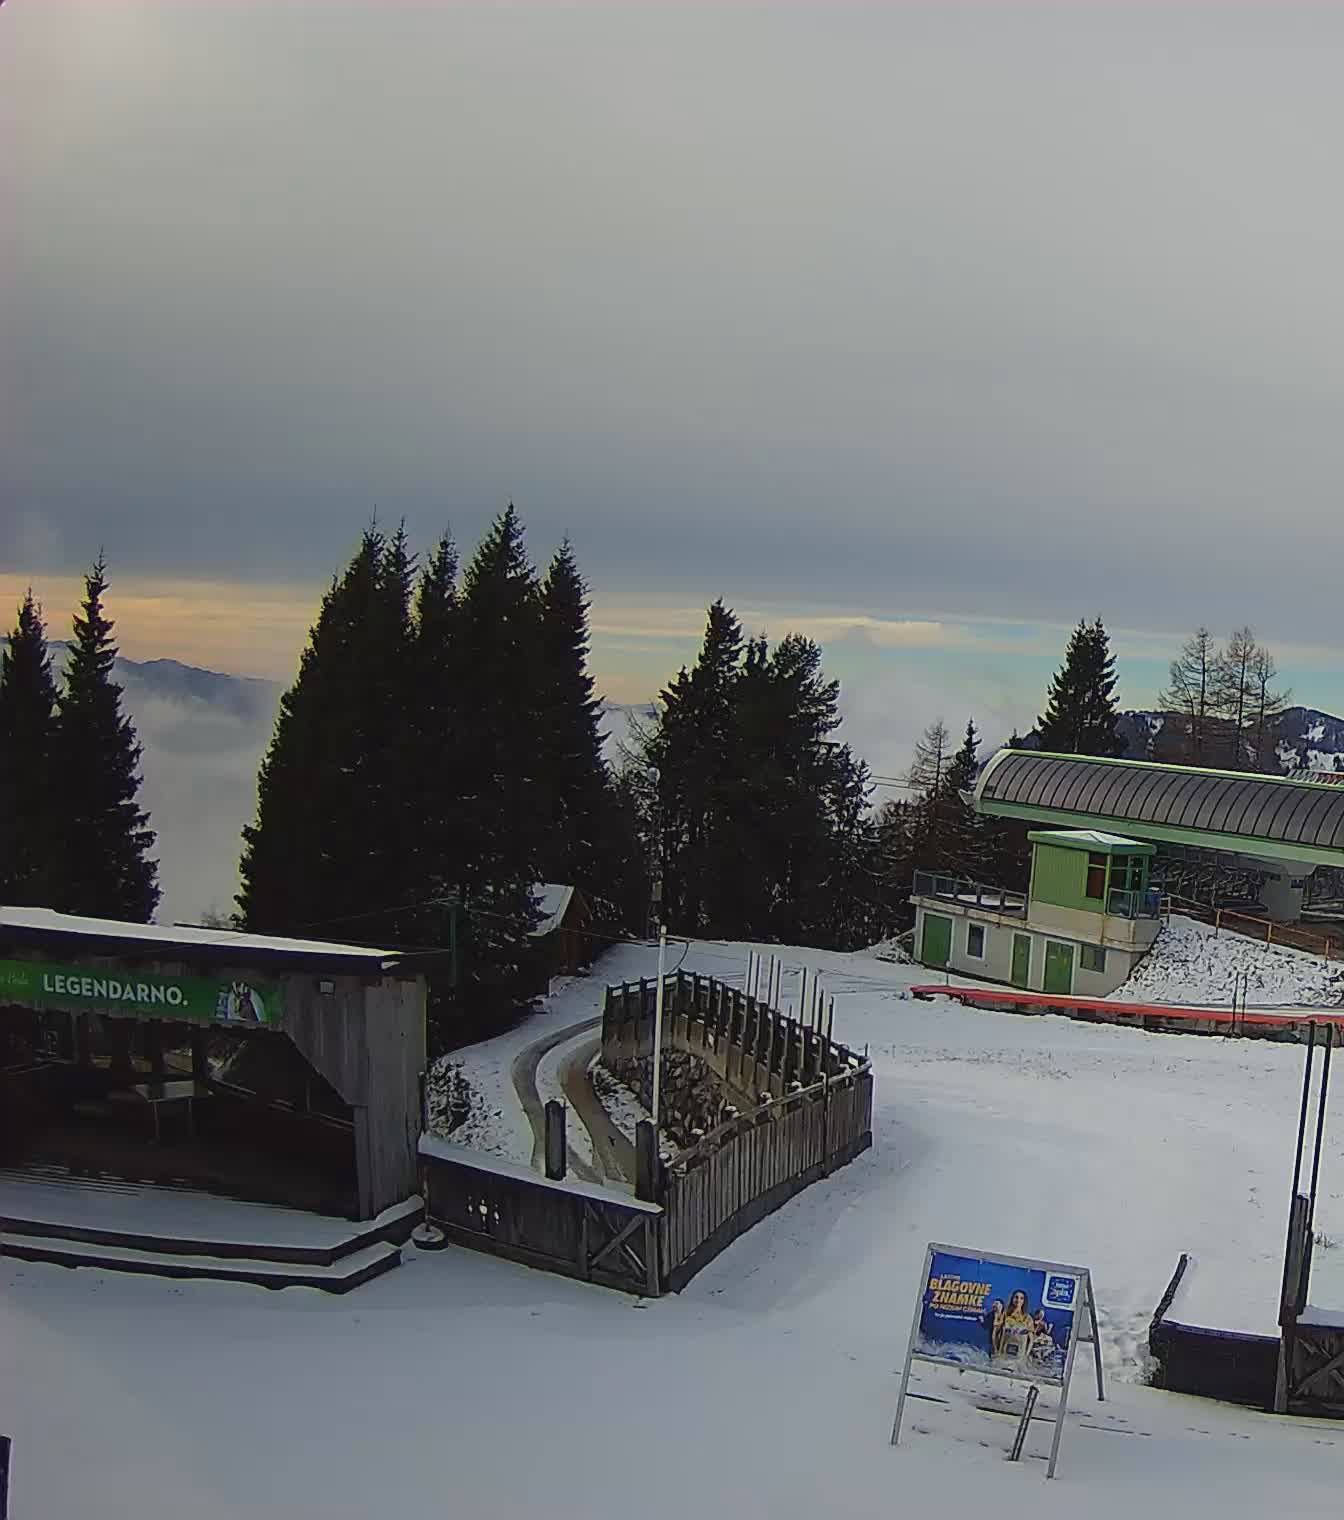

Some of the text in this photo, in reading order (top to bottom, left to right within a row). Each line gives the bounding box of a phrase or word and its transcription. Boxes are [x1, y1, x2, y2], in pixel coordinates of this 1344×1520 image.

[43, 973, 189, 1007] LEGENDARNO.
[928, 1278, 993, 1296] BLAGOVNE
[931, 1291, 985, 1307] ZNAMKE
